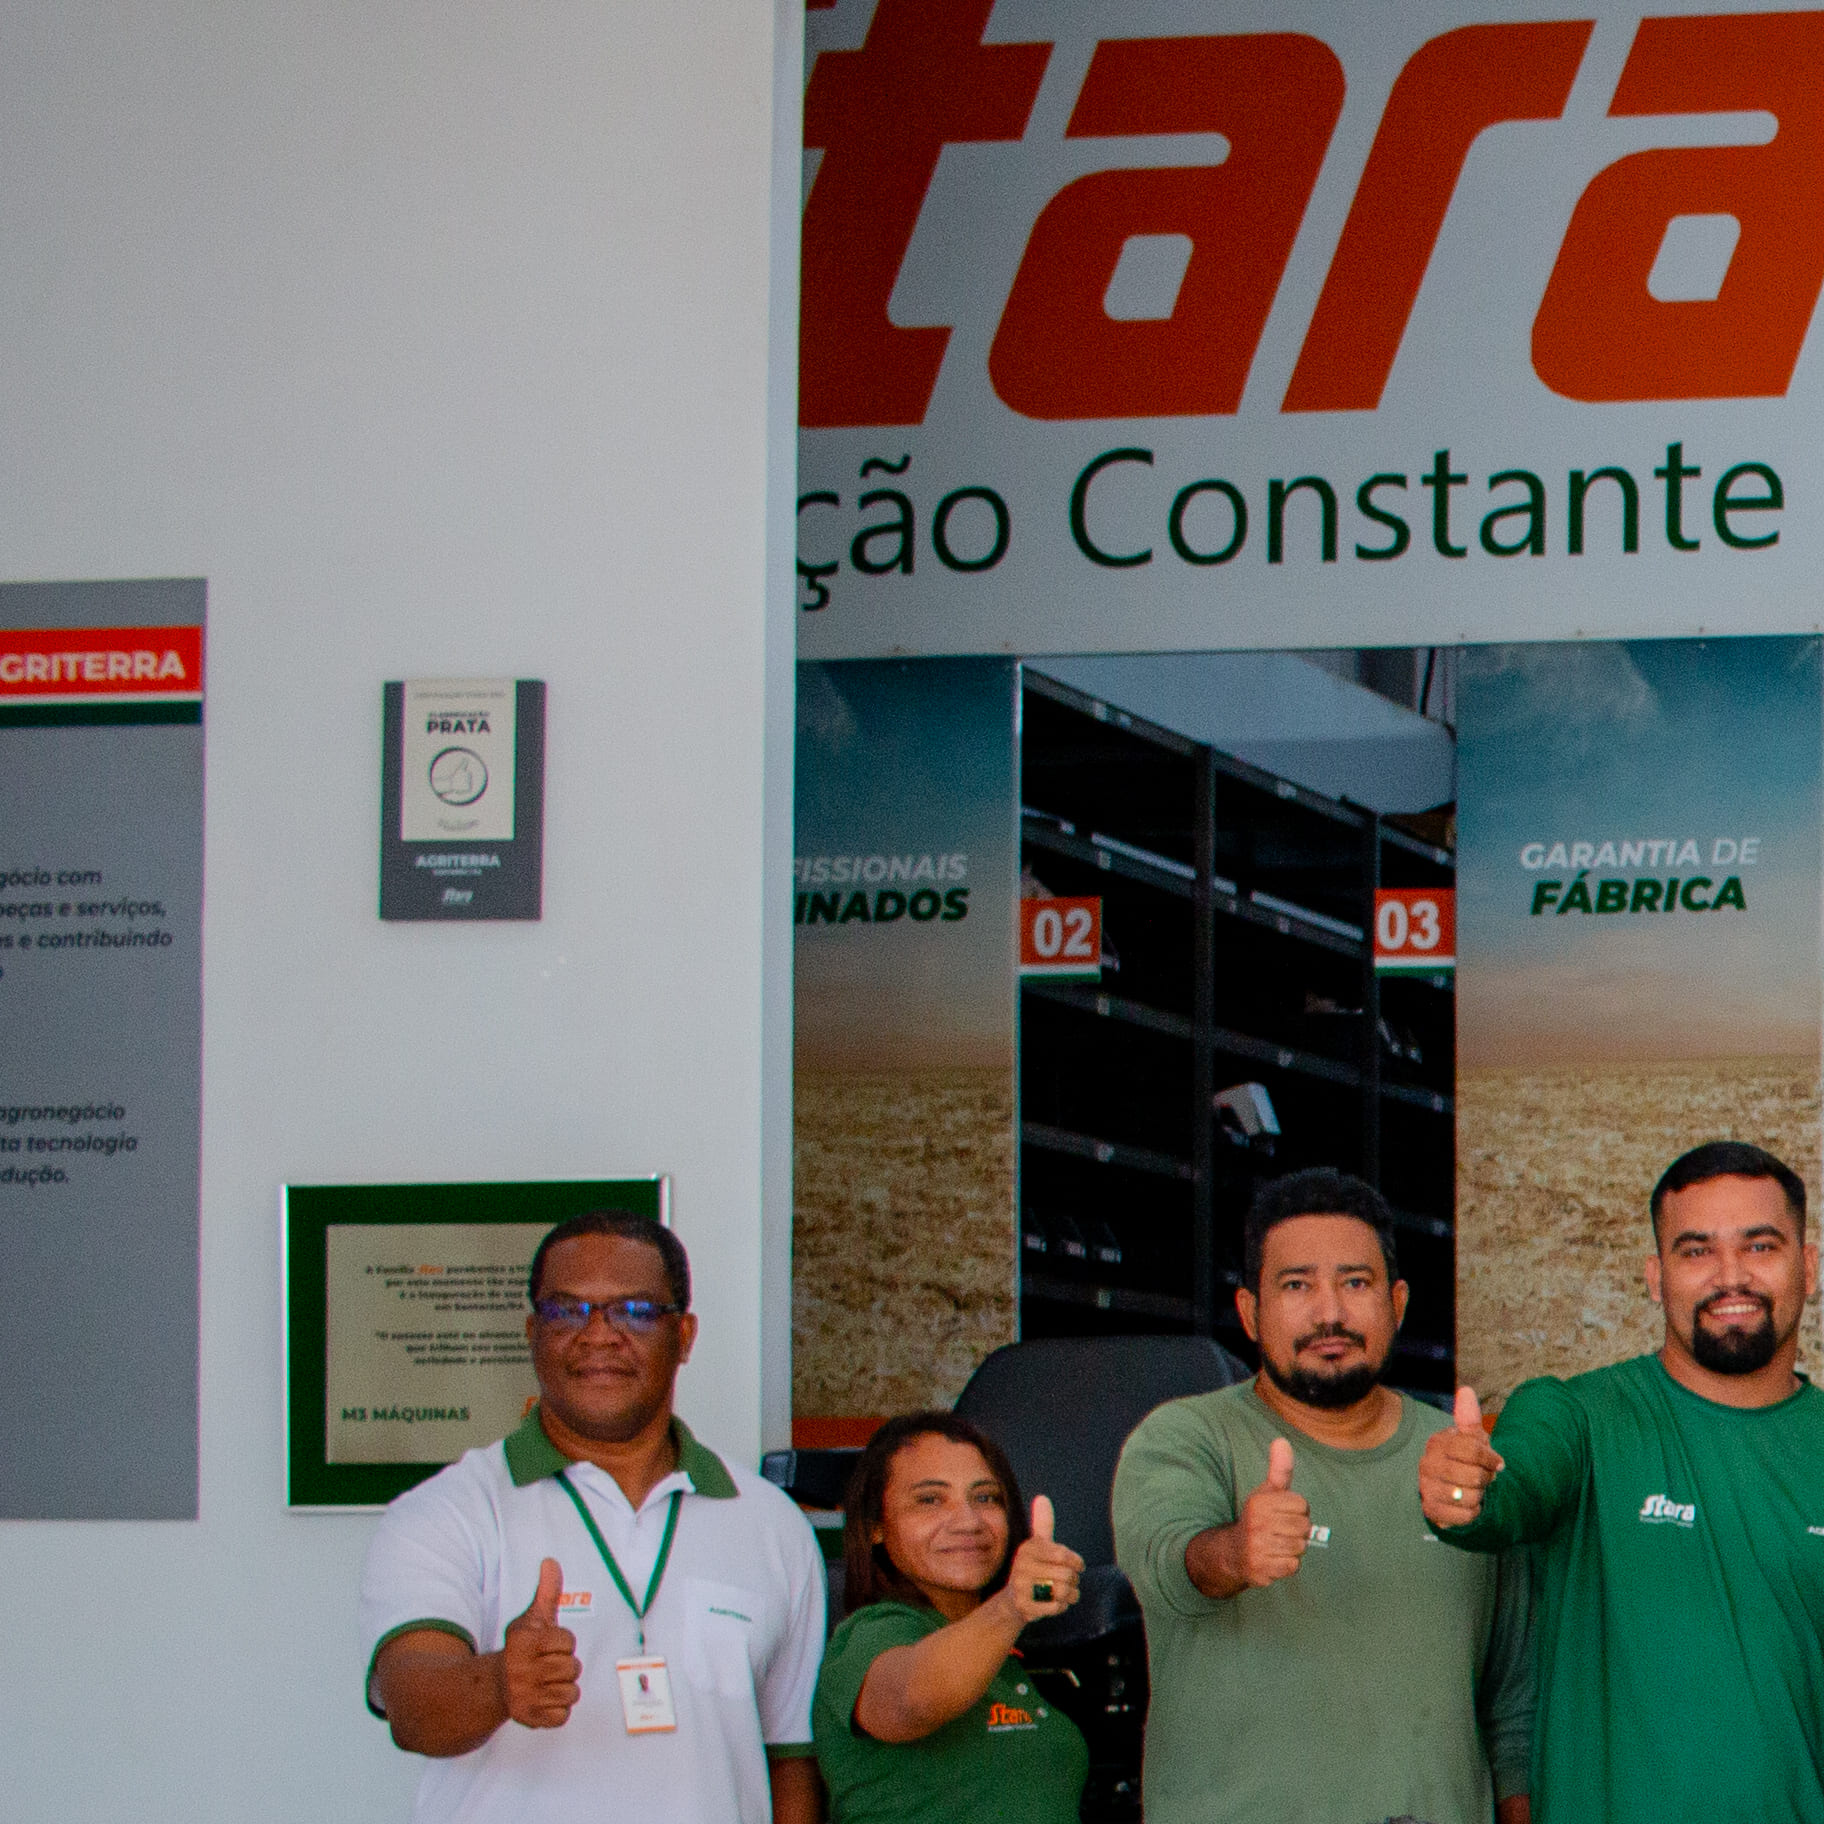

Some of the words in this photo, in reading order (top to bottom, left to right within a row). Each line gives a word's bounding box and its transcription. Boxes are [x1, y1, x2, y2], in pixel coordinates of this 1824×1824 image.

[799, 454, 1012, 612] ção
[1069, 442, 1785, 568] Constante
[0, 650, 187, 682] GRITERRA
[427, 719, 491, 733] PRATA
[1520, 839, 1700, 870] GARANTIA
[1711, 838, 1760, 866] DE
[57, 869, 102, 886] com
[1530, 868, 1746, 915] FÁBRICA
[60, 904, 72, 918] e
[77, 898, 166, 921] serviços,
[796, 888, 970, 924] INADOS
[19, 934, 32, 948] e
[37, 930, 174, 949] contribuindo
[1033, 907, 1093, 958] 02
[1377, 900, 1441, 949] 03
[27, 1132, 138, 1156] tecnologia
[372, 1403, 470, 1423] MÁQUINAS
[1641, 1494, 1696, 1522] Stara
